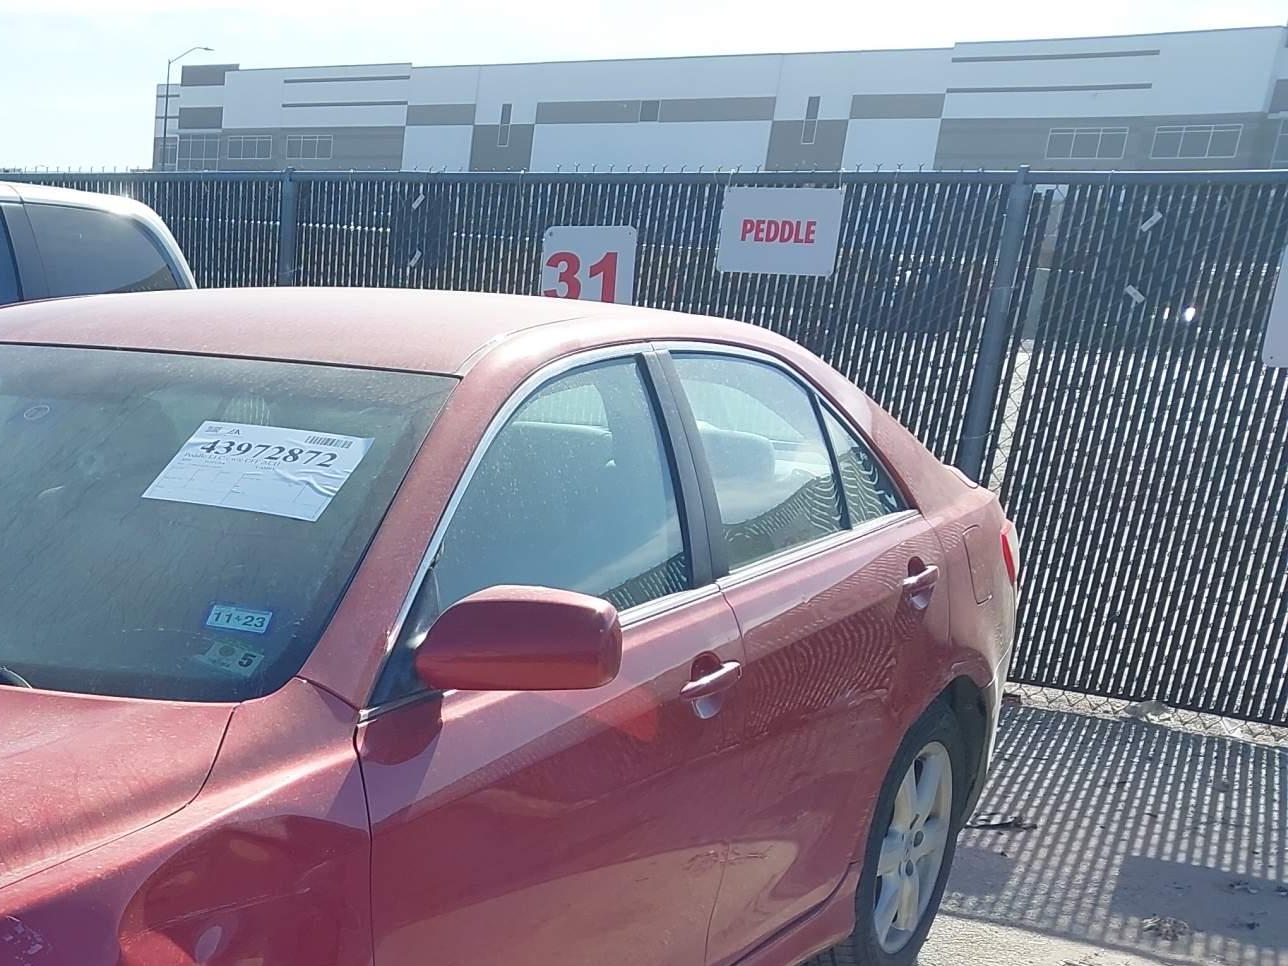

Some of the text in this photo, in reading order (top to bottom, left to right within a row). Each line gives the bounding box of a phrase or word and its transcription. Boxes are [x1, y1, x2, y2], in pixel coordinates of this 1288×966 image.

[740, 219, 817, 244] PEDDLE
[543, 251, 618, 304] 31
[200, 439, 338, 468] 43972872
[238, 652, 257, 668] 5
